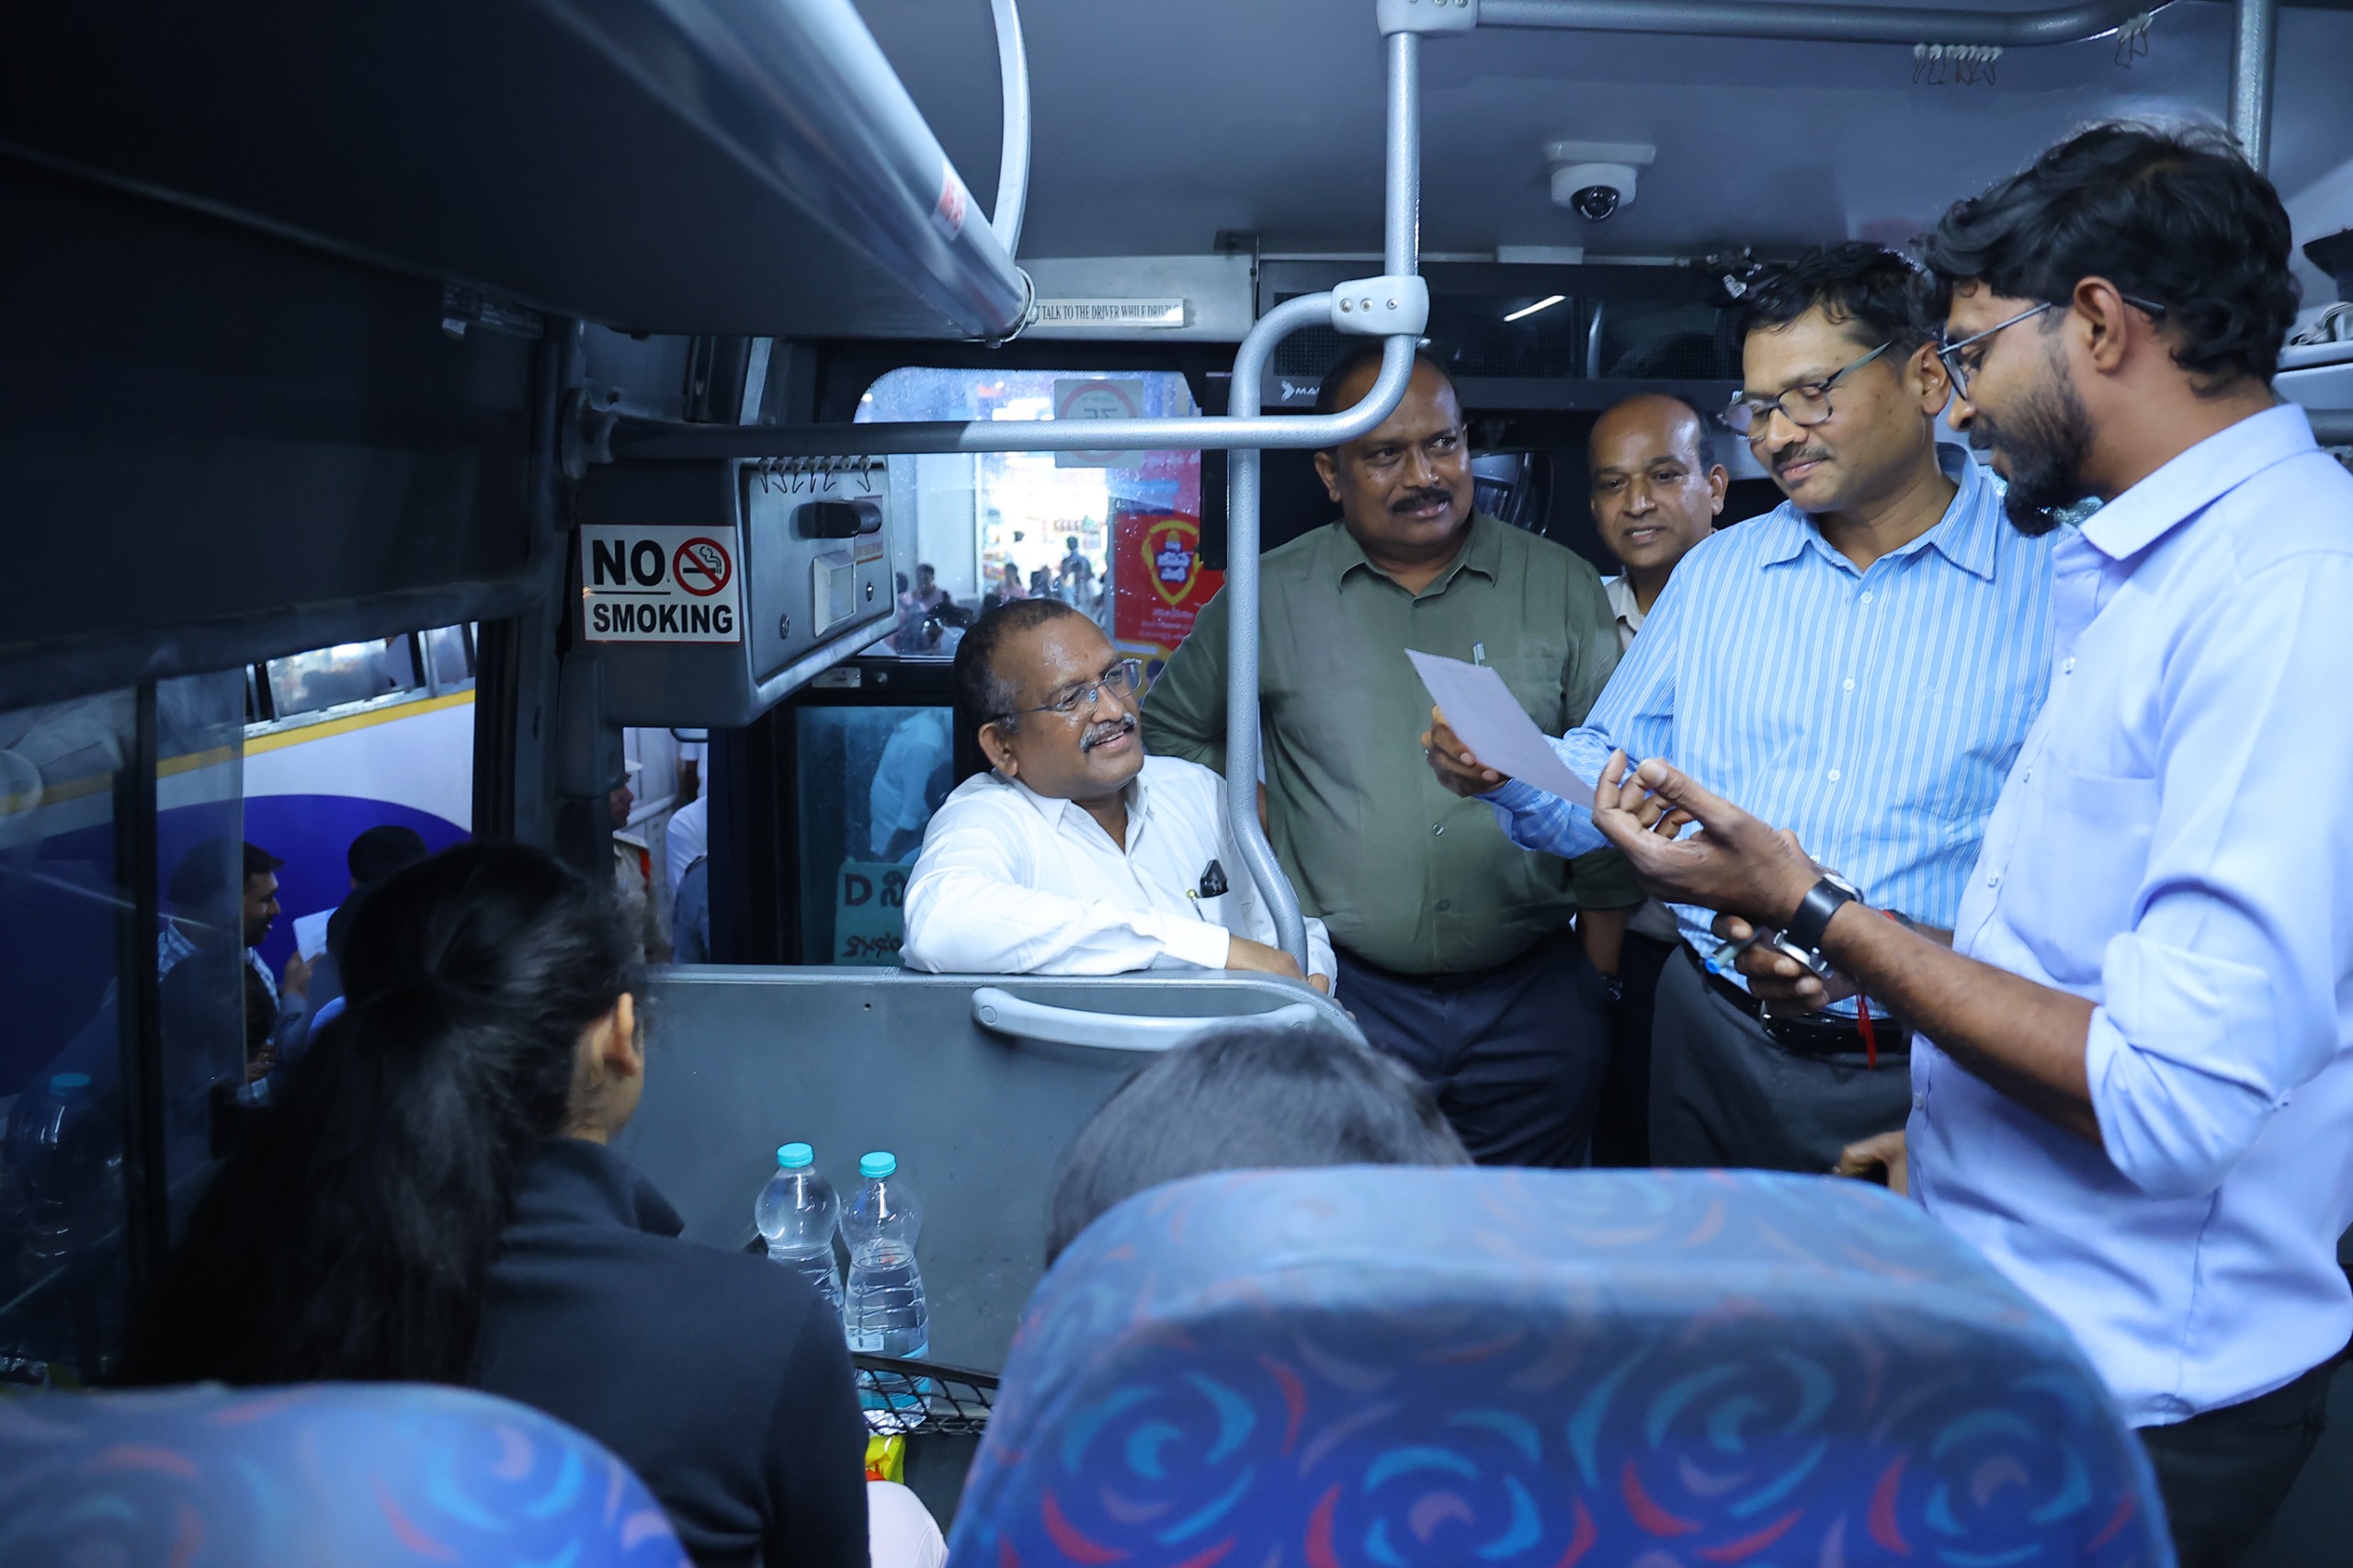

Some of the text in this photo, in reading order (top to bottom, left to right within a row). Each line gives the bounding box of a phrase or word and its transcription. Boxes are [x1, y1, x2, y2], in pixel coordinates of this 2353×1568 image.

[1042, 305, 1062, 320] TALK
[1063, 305, 1074, 320] TO
[1075, 305, 1089, 320] THE
[1091, 305, 1120, 320] DRIVER
[1120, 305, 1145, 319] WHILE
[593, 540, 665, 586] NO
[593, 604, 733, 634] SMOKING
